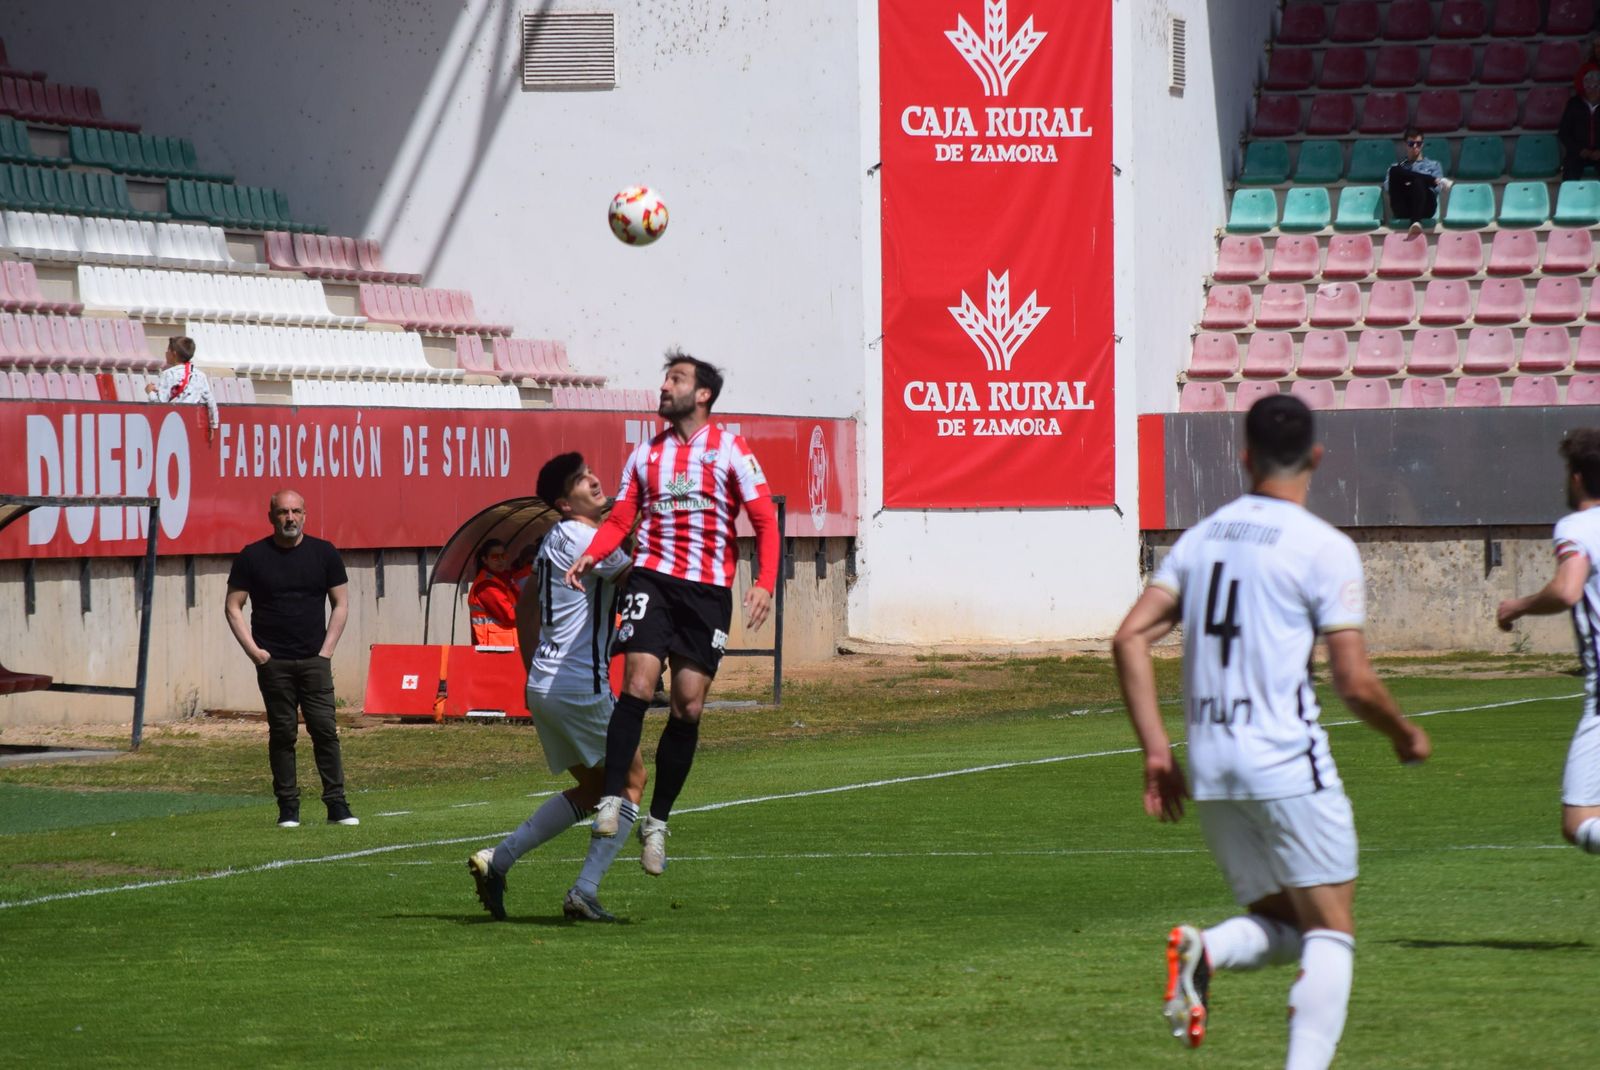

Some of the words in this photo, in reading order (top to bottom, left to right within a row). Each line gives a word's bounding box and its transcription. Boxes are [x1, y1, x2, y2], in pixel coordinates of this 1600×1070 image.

[901, 106, 978, 138] CAJA
[985, 107, 1092, 137] RURAL
[935, 144, 963, 161] DE
[970, 144, 1058, 162] ZAMORA
[903, 381, 981, 413] CAJA
[988, 381, 1095, 411] RURAL
[937, 419, 966, 436] DE
[973, 418, 1062, 436] ZAMORA
[220, 411, 382, 478] FABRICACIÓN
[403, 425, 429, 476] DE
[442, 426, 510, 478] STAND
[27, 411, 191, 545] DUERO
[621, 593, 650, 620] 23
[1204, 562, 1241, 669] 4
